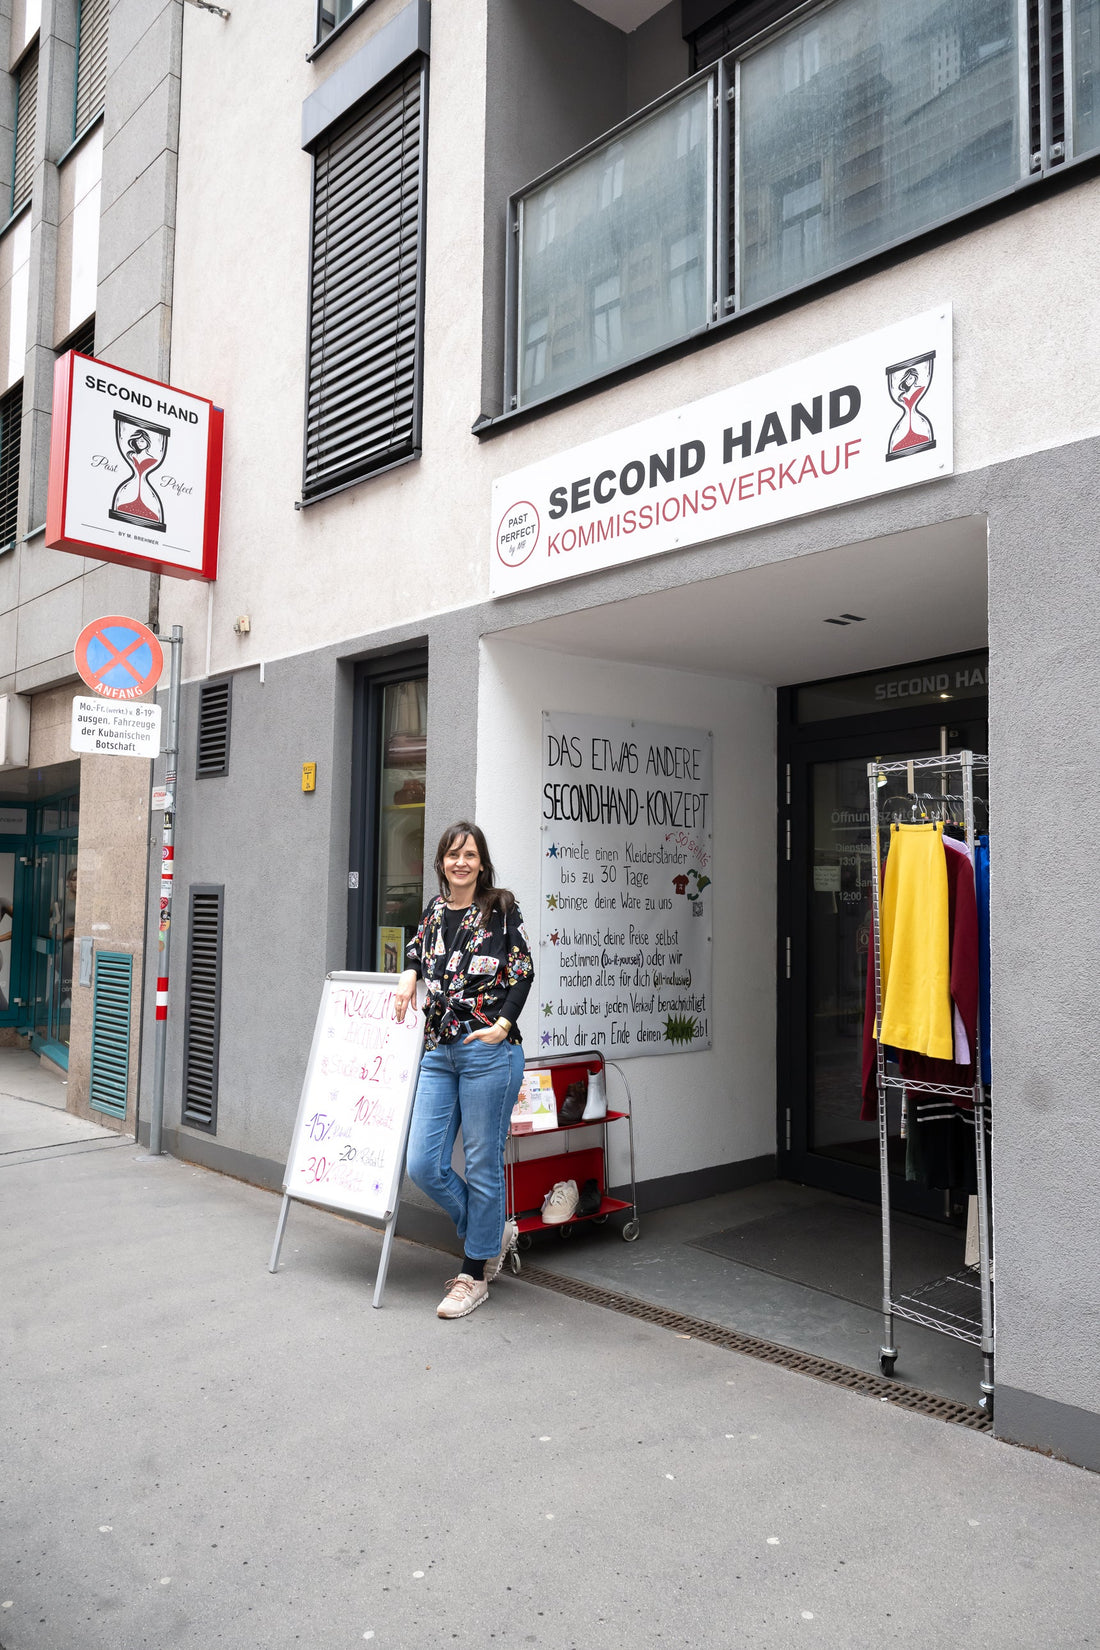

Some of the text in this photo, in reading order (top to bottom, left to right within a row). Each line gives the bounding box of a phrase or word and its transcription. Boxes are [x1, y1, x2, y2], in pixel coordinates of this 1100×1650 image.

[85, 375, 199, 425] SECOND HAND
[90, 454, 118, 473] Past
[548, 384, 862, 521] SECOND HAND
[160, 475, 193, 496] Perfect
[547, 438, 862, 558] KOMMISSIONSVERKAUF
[508, 513, 528, 528] PAST
[501, 524, 536, 544] PERFECT
[94, 682, 143, 699] ANFANG
[875, 673, 949, 700] SECOND
[78, 714, 156, 730] ausgen. Fahrzeuge
[81, 727, 151, 741] der Kubanischen
[95, 739, 136, 751] Botschaft
[547, 734, 701, 780] DAS ETWAS ANDERE
[543, 783, 709, 829] SECONDHAND-KONZEPT
[560, 840, 688, 865] miete einen Kleiderständer
[836, 842, 872, 853] Diensta
[560, 865, 649, 888] bis zu 30 Tage
[558, 891, 673, 911] bringe deine Ware zu uns
[839, 891, 862, 901] 12:00
[560, 924, 679, 947] du kannst deine Preise selbst
[646, 948, 666, 968] oder
[668, 950, 683, 966] wir
[559, 970, 592, 988] machen
[595, 969, 615, 987] alles
[619, 968, 631, 987] für
[633, 968, 650, 987] dich
[557, 999, 568, 1016] du
[570, 997, 588, 1015] wirst
[590, 997, 601, 1015] bei
[604, 995, 628, 1018] jeden
[629, 992, 655, 1014] Verkauf
[552, 1026, 569, 1047] hol
[574, 1024, 588, 1046] dir
[591, 1032, 606, 1046] am
[611, 1021, 630, 1045] Ende
[636, 1020, 661, 1043] deinen
[304, 1112, 336, 1142] -15%
[300, 1156, 336, 1185] -30%
